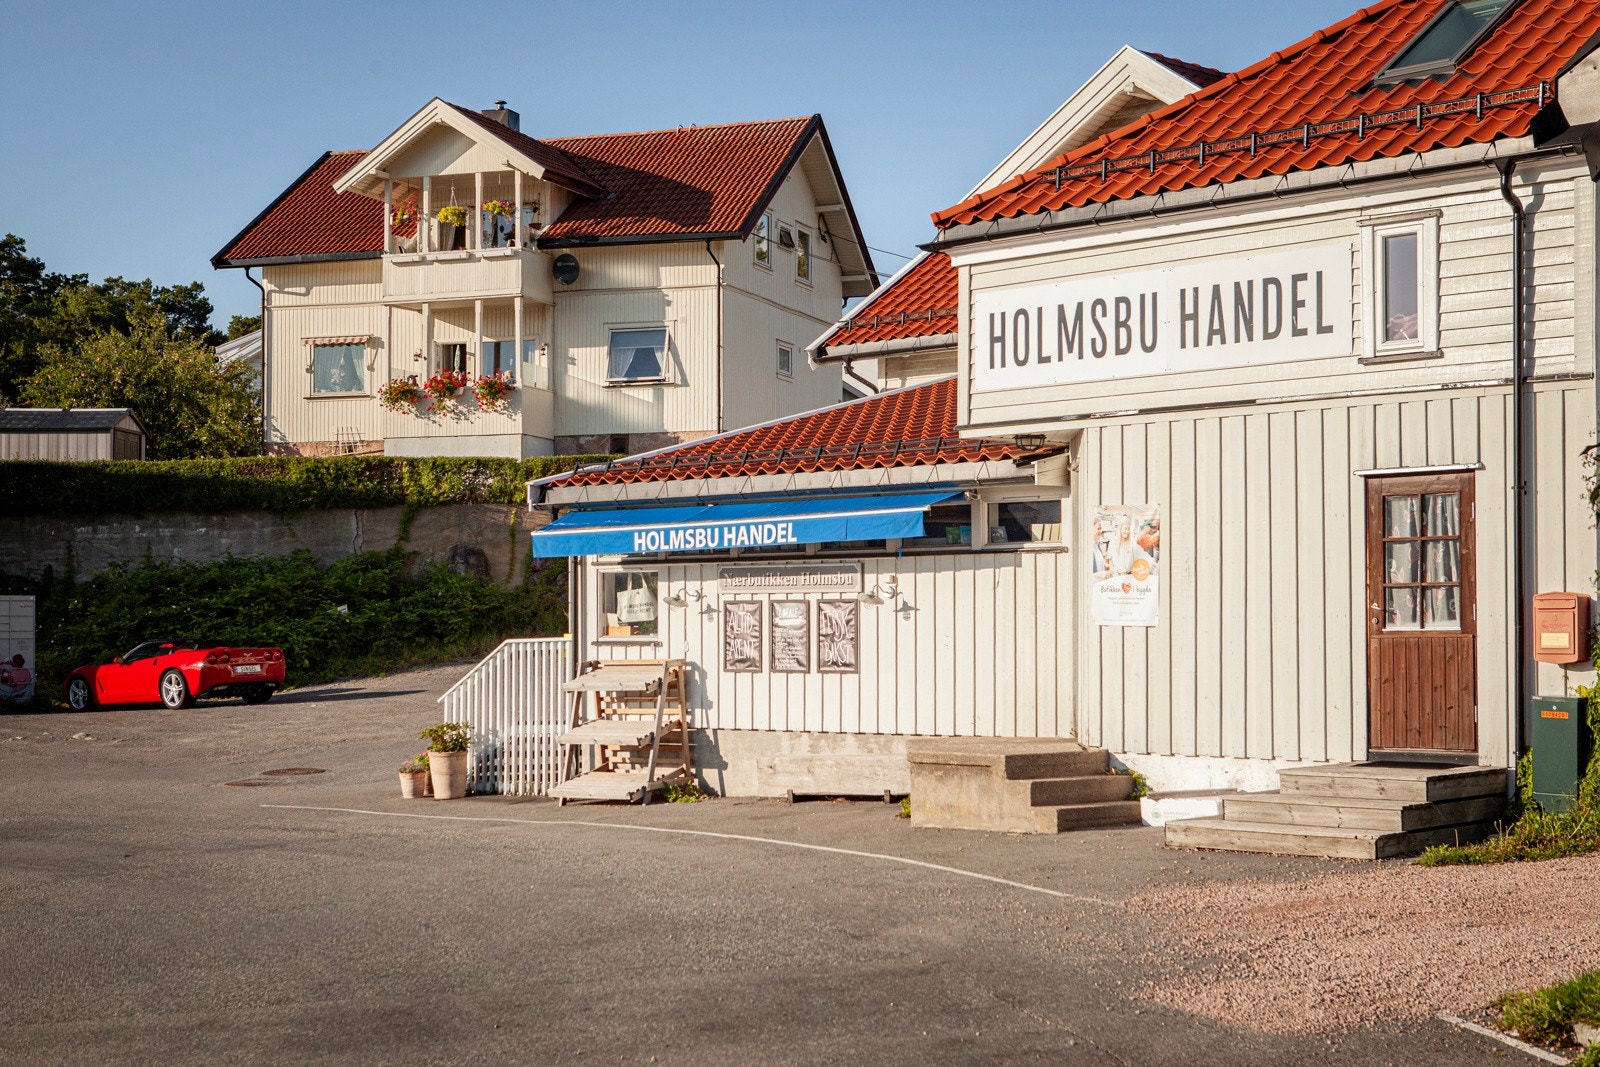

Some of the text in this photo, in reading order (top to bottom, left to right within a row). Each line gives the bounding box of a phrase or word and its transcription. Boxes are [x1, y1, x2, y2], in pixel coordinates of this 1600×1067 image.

[988, 270, 1334, 370] HOLMSBU HANDEL
[633, 522, 798, 551] HOLMSBU HANDEL
[724, 571, 854, 587] Nærbutikken Holmsbu
